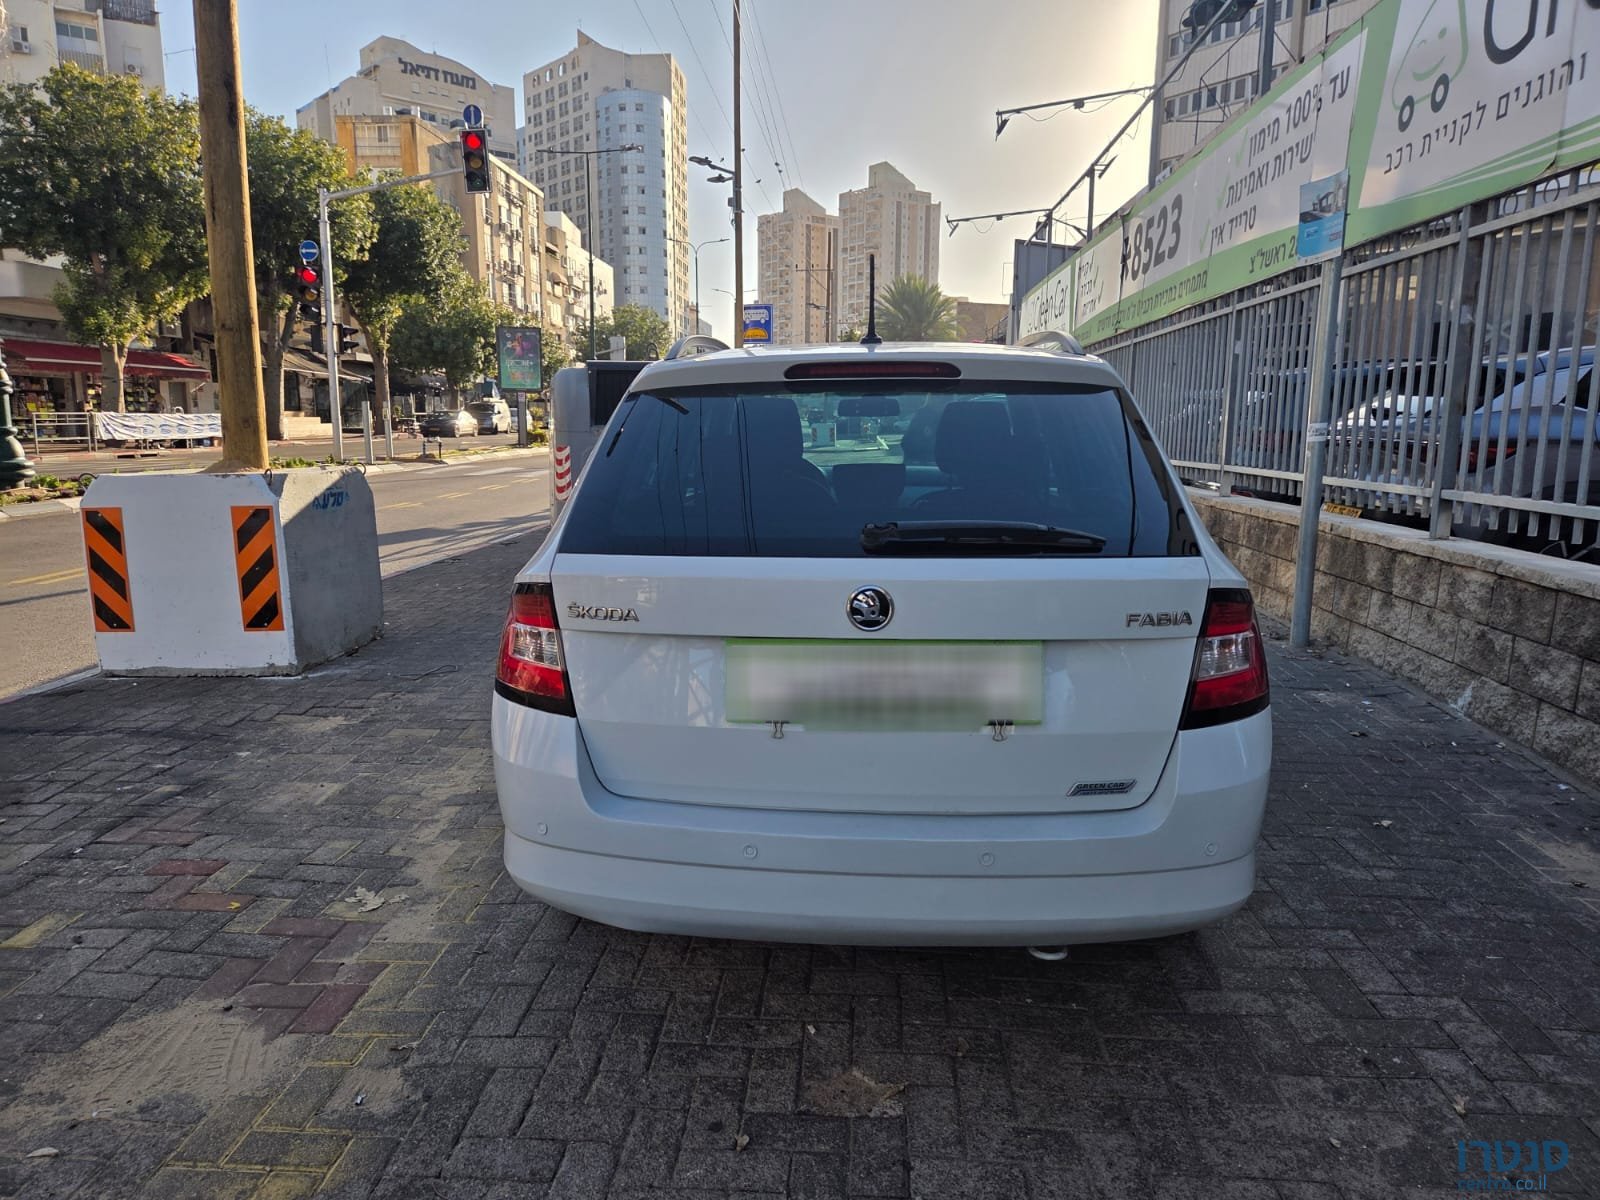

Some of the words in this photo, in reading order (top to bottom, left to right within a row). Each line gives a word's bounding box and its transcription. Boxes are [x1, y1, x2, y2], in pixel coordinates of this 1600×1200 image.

[398, 57, 440, 81] דניאל
[1329, 65, 1351, 104] עד
[1496, 52, 1588, 120] והוגנים
[1248, 116, 1280, 167] מימון
[1420, 100, 1487, 157] לקניית
[1271, 132, 1313, 181] שירות
[1384, 142, 1413, 175] רכב
[1226, 161, 1270, 209] ואמינות
[1210, 222, 1226, 257] אין
[1228, 204, 1257, 240] טרייד
[567, 601, 640, 622] ŠKODA
[1126, 609, 1193, 627] FABIA
